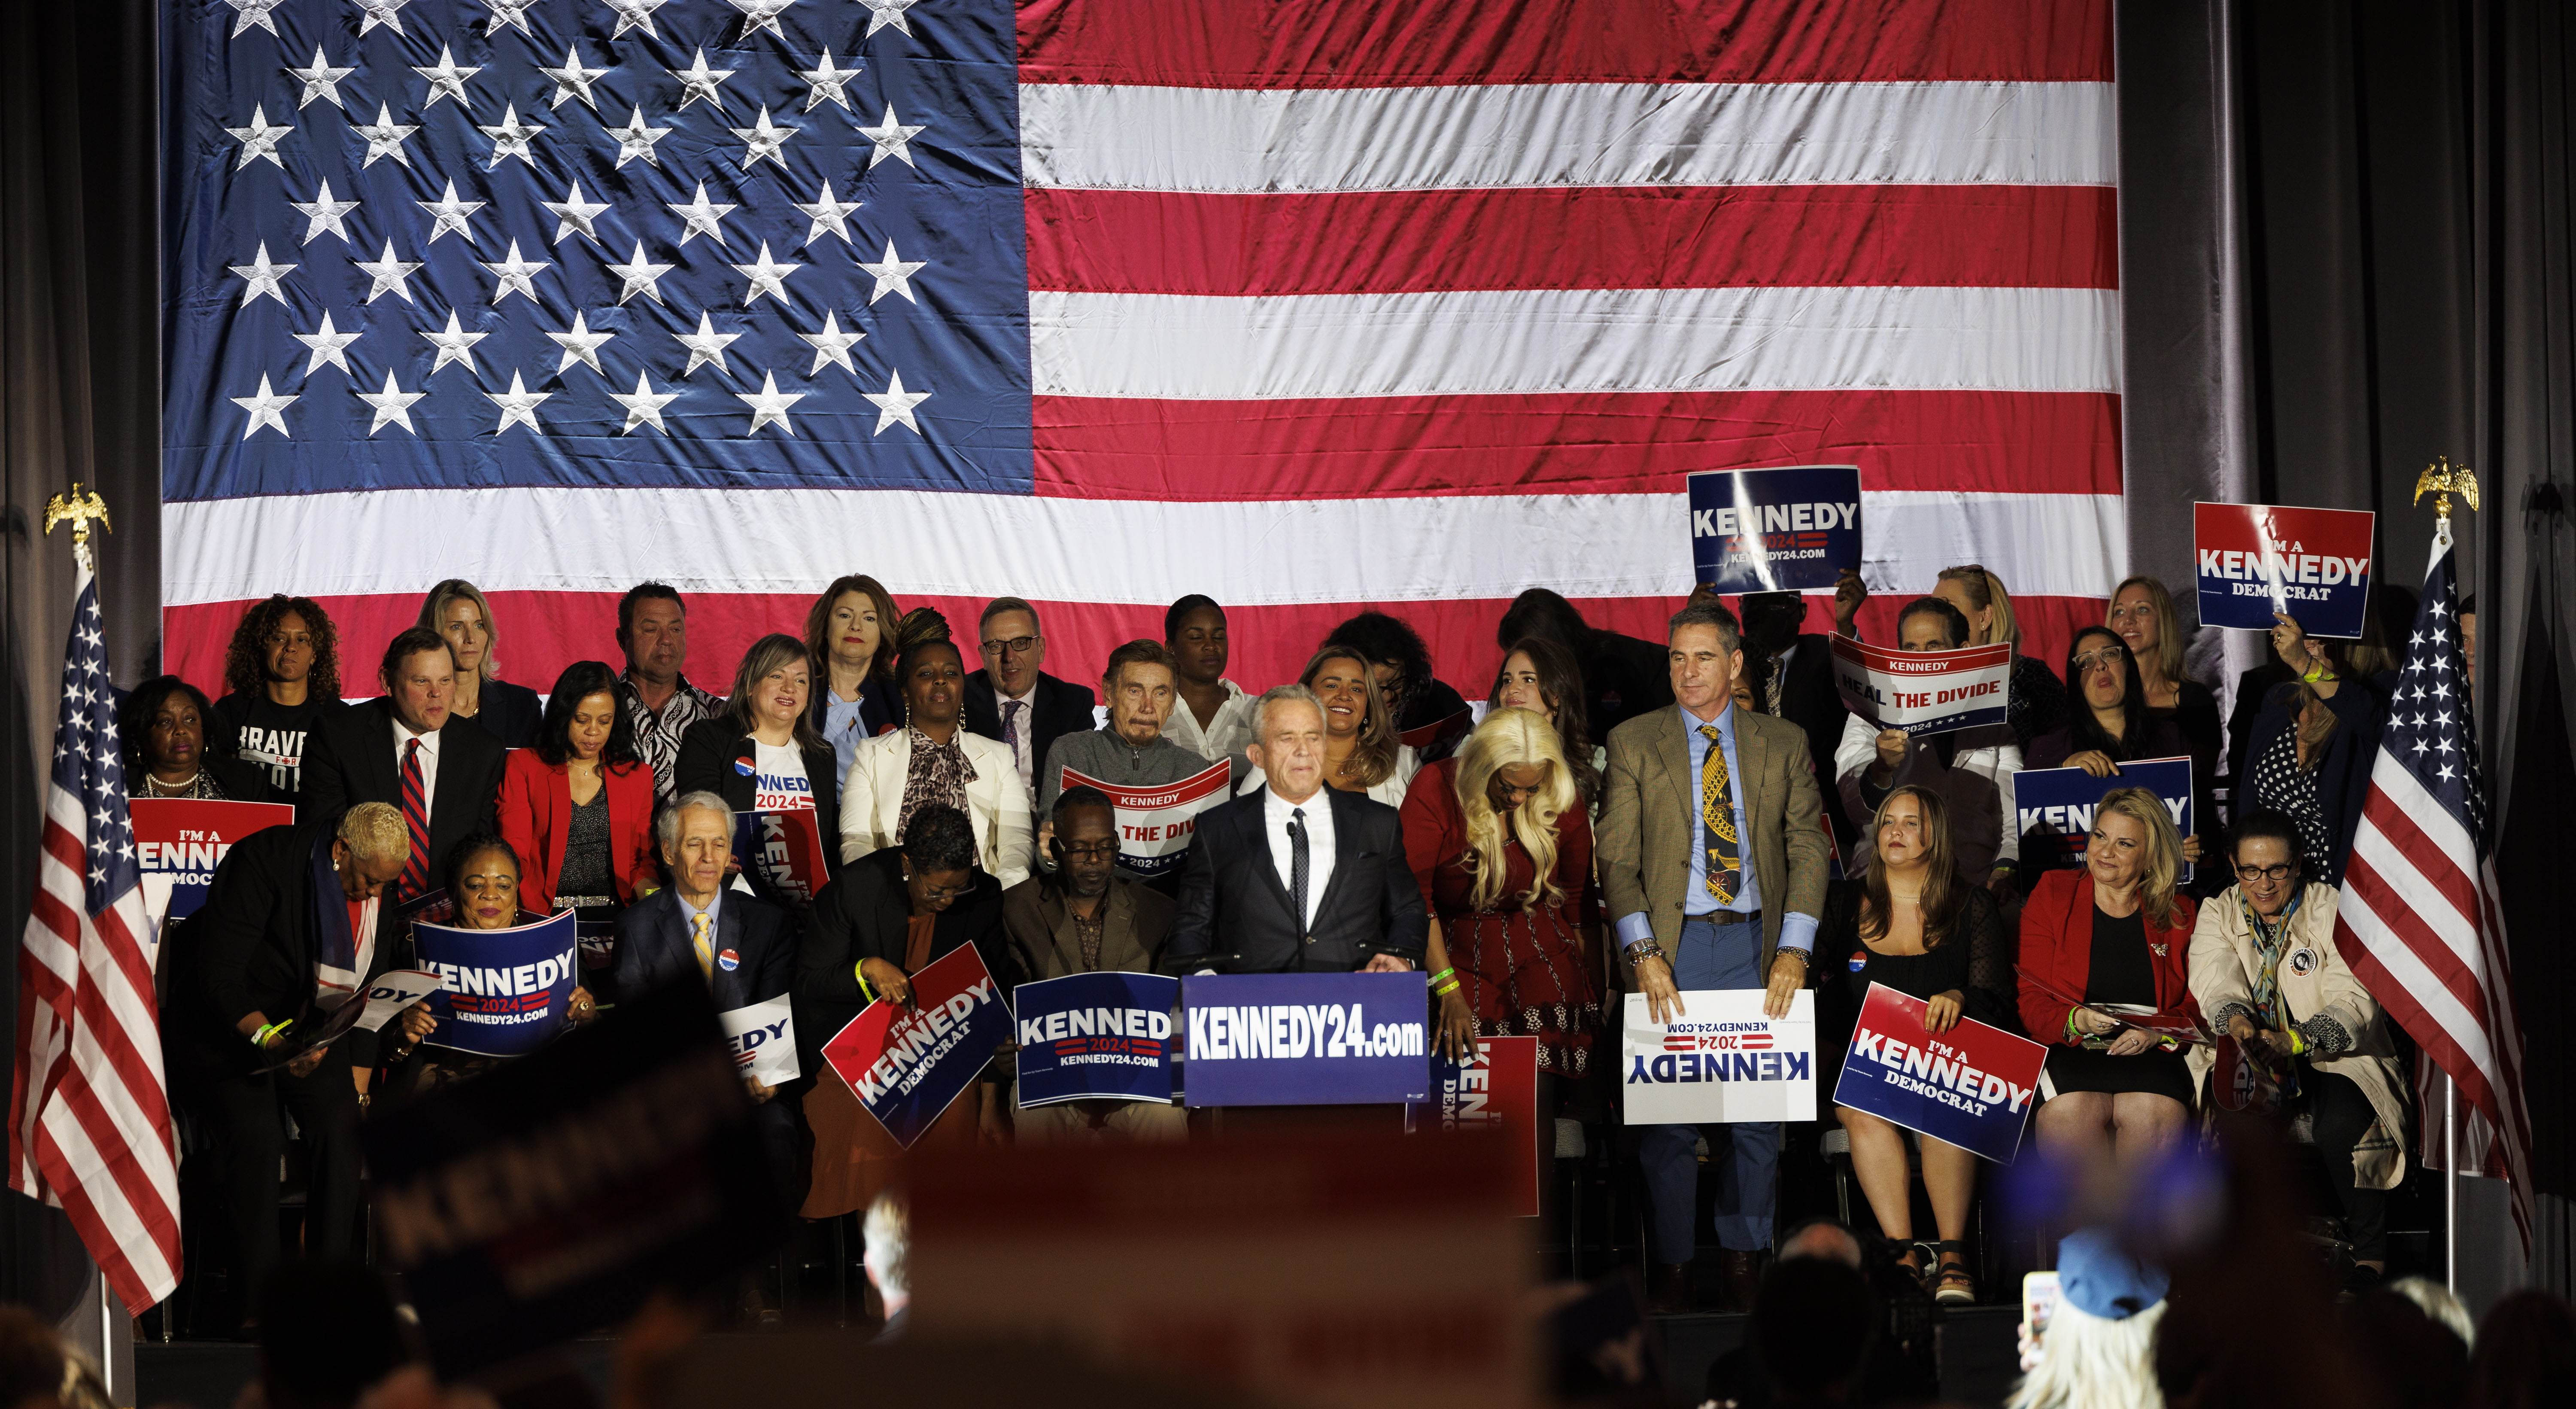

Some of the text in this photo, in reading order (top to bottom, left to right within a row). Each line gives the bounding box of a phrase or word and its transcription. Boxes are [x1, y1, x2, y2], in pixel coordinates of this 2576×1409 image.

[1694, 502, 1857, 538] KENNEDY
[2290, 541, 2304, 552] A
[2200, 549, 2368, 586] KENNEDY
[2233, 583, 2331, 600] DEMOCRAT
[1890, 661, 1949, 671] KENNEDY
[1842, 673, 2000, 708] HEAL THE DIVIDE
[1903, 722, 1932, 733] 2024
[735, 760, 755, 771] Kennedy
[756, 774, 810, 792] NNED
[756, 794, 798, 809] 2024
[1121, 793, 1179, 806] KENNEDY
[179, 830, 221, 842] I'M A
[1122, 819, 1195, 841] THE DIV
[1130, 858, 1160, 867] 2024
[418, 947, 574, 996] KENNEDY
[480, 998, 519, 1012] 2024
[456, 1007, 547, 1025] KENNEDY24.COM
[890, 1008, 926, 1038] I'M A
[1021, 1007, 1172, 1046] KENNED
[1189, 1003, 1423, 1060] KENNEDY24.com
[1668, 1023, 1768, 1033] KENNEDY24.COM
[855, 976, 991, 1107] KENNEDY
[1090, 1038, 1130, 1052] 2024
[1699, 1036, 1738, 1050] 2024
[898, 1021, 970, 1096] DEMOCRAT
[1060, 1054, 1158, 1067] KENNEDY24.COM
[1928, 1040, 1968, 1064] I'M A
[1627, 1052, 1809, 1084] KENNEDY
[1854, 1028, 2032, 1114] KENNEDY
[1884, 1071, 1987, 1117] DEMOCRAT
